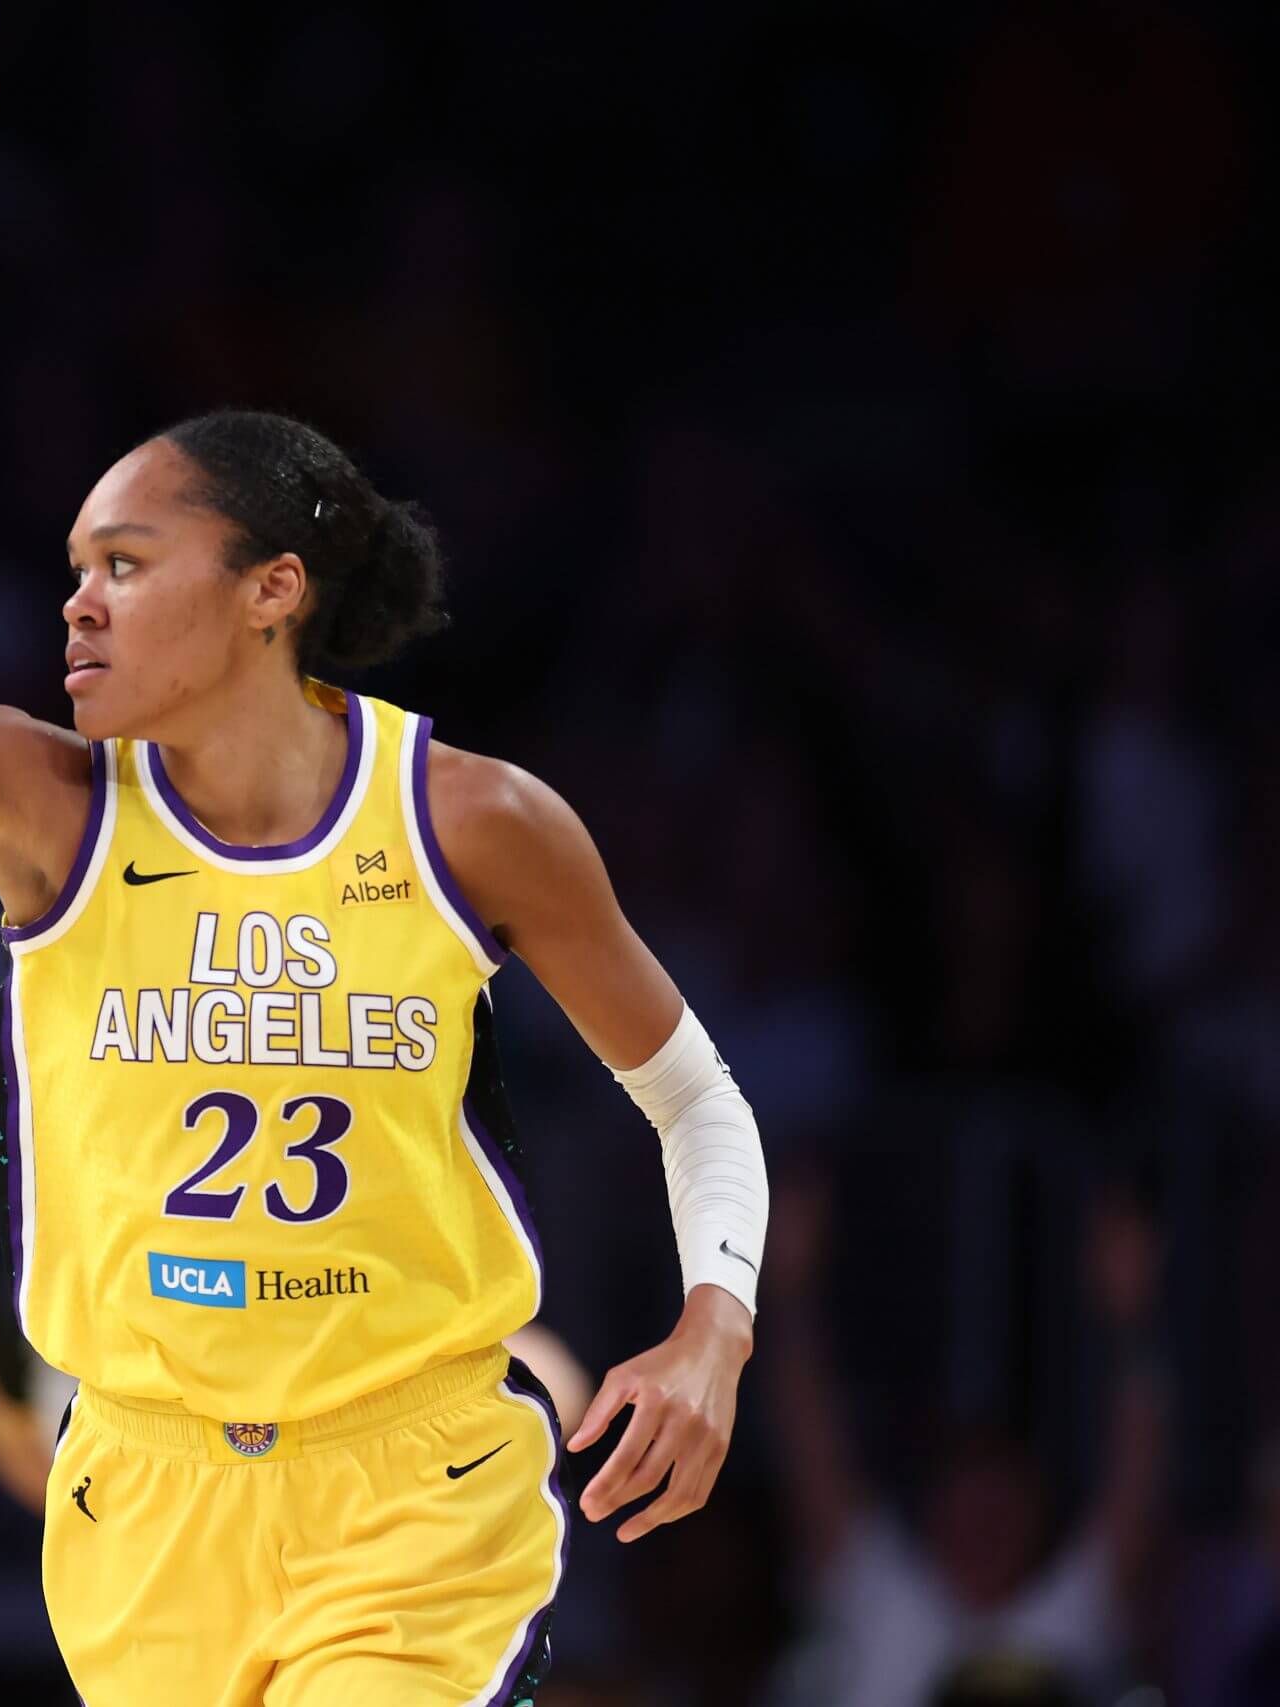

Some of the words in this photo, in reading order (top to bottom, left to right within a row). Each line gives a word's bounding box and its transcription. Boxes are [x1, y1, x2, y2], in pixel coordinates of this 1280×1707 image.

[341, 880, 411, 905] Albert
[189, 911, 337, 988] LOS
[89, 988, 437, 1072] ANGELES
[162, 1090, 353, 1224] 23
[161, 1264, 233, 1297] UCLA
[255, 1267, 370, 1300] Health
